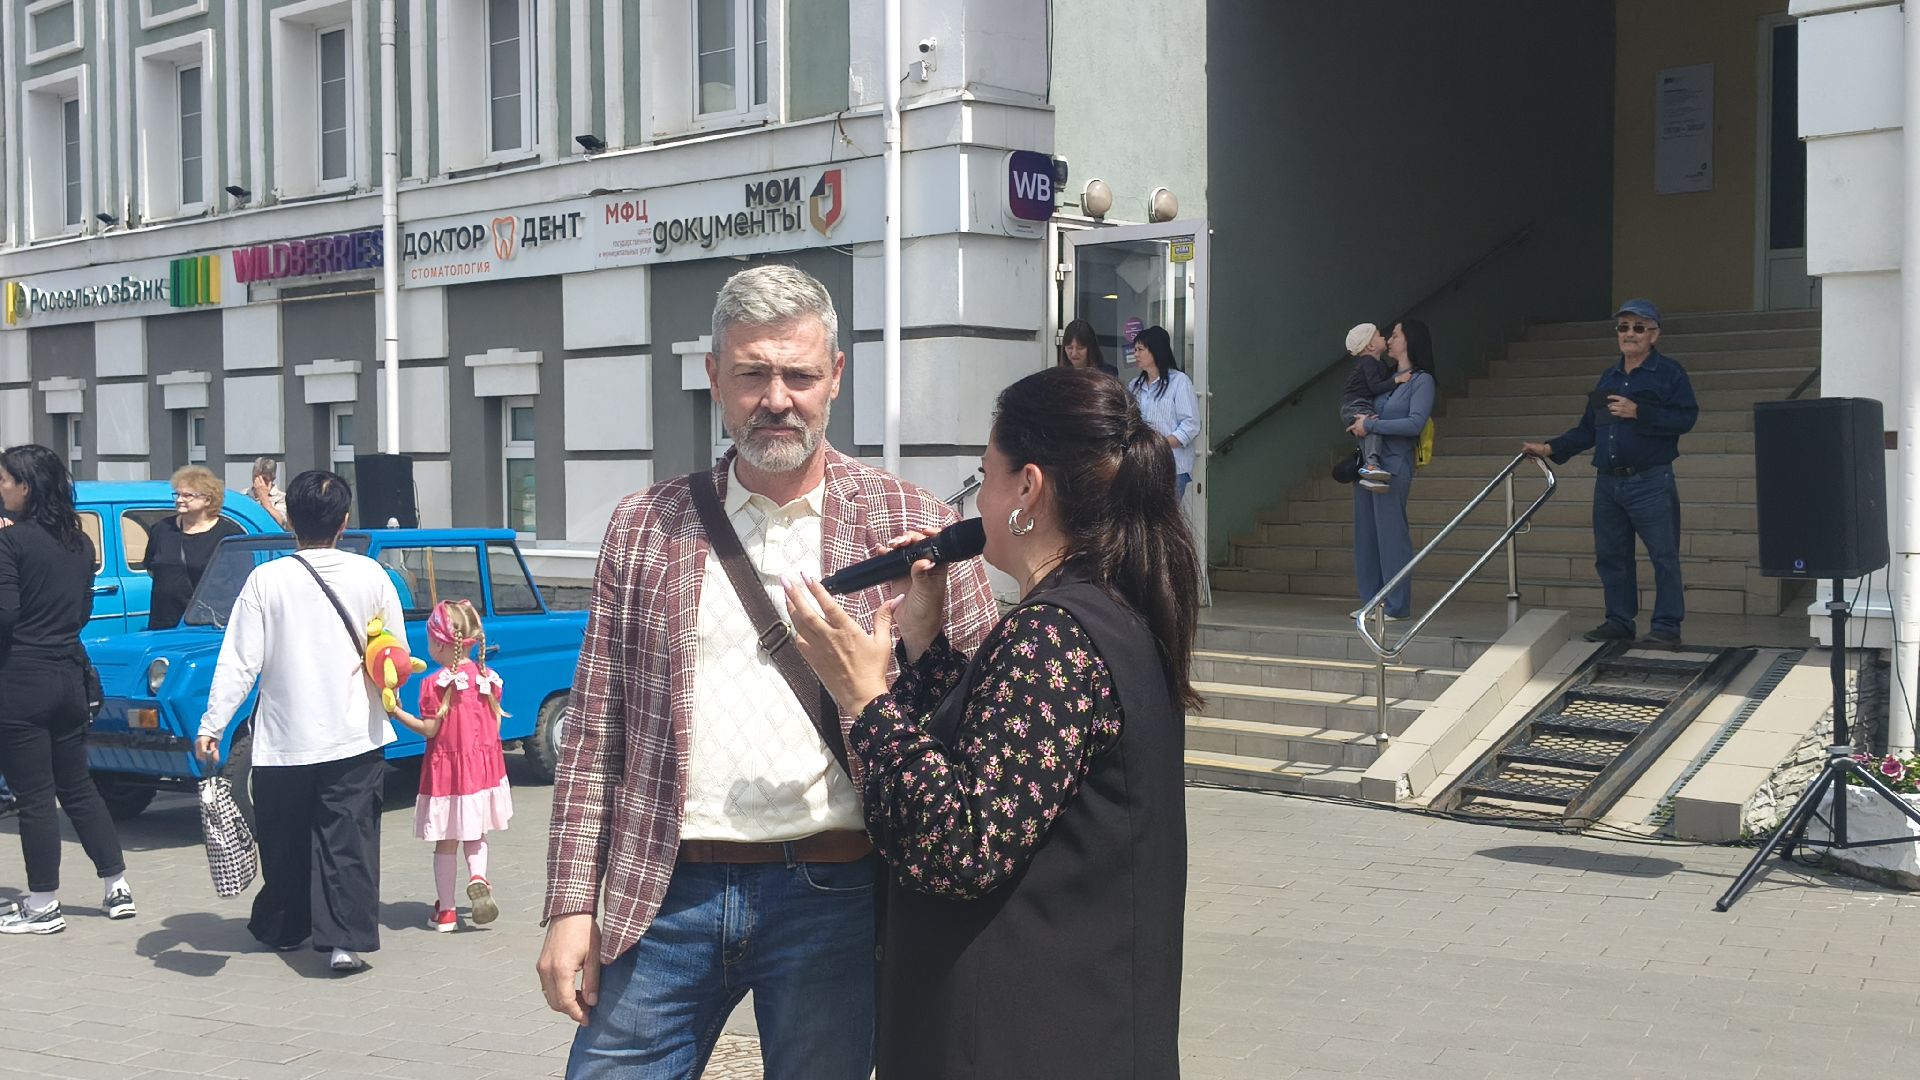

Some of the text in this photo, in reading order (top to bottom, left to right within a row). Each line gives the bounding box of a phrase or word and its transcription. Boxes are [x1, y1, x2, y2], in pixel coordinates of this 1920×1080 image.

[1012, 170, 1051, 202] WB
[605, 200, 648, 224] МФЦ
[653, 206, 801, 253] документы
[403, 212, 581, 260] ДОКТОР ДЕНТ
[232, 230, 384, 283] WILDBERRIES
[411, 261, 490, 280] СТОМАТОЛОГИЯ
[30, 276, 164, 313] РоссельхозБанк
